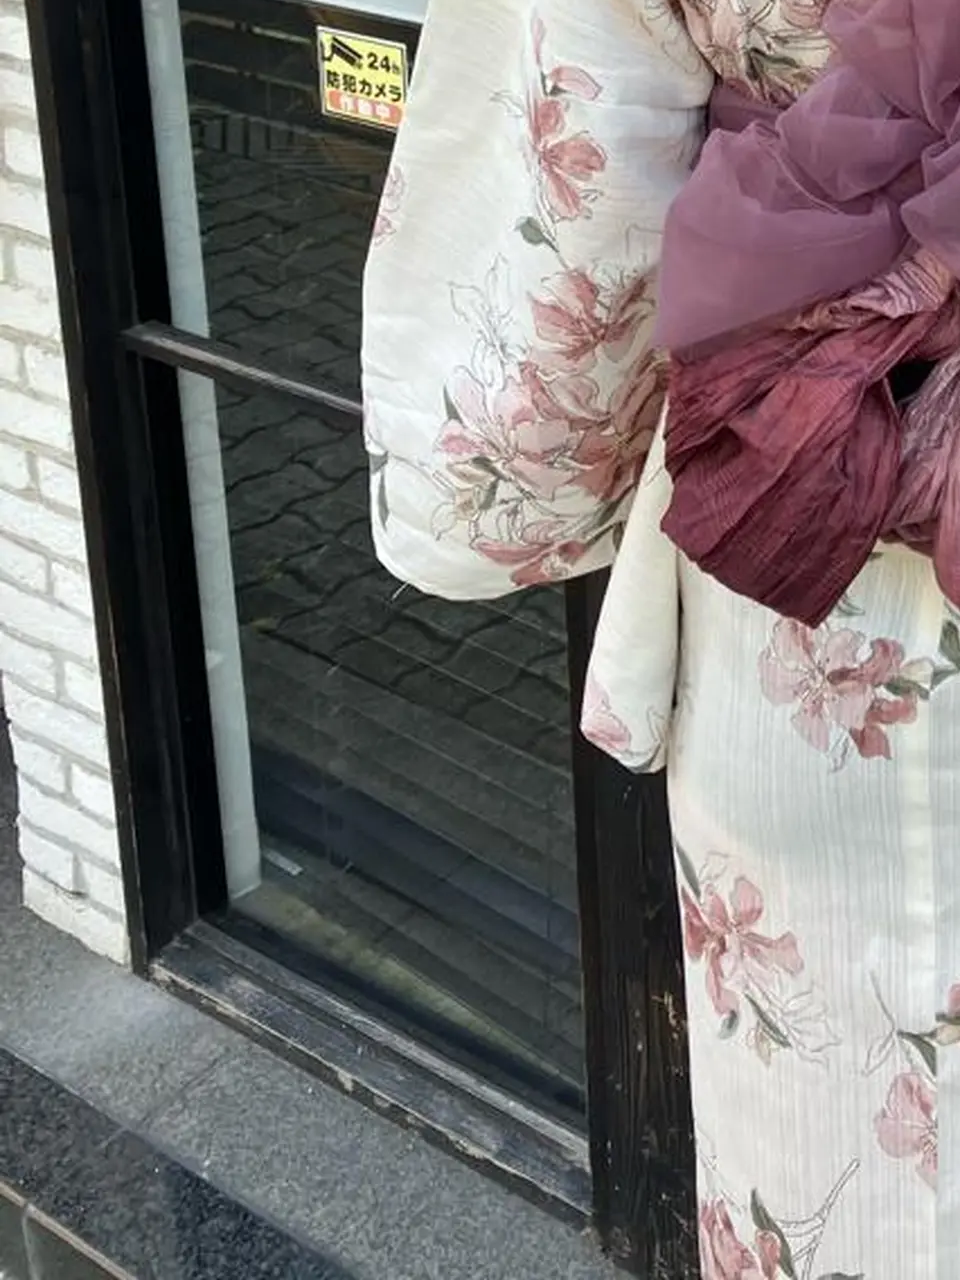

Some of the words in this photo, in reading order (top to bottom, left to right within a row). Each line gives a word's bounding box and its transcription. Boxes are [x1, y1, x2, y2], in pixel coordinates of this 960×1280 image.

[326, 69, 402, 103] 防犯カメラ
